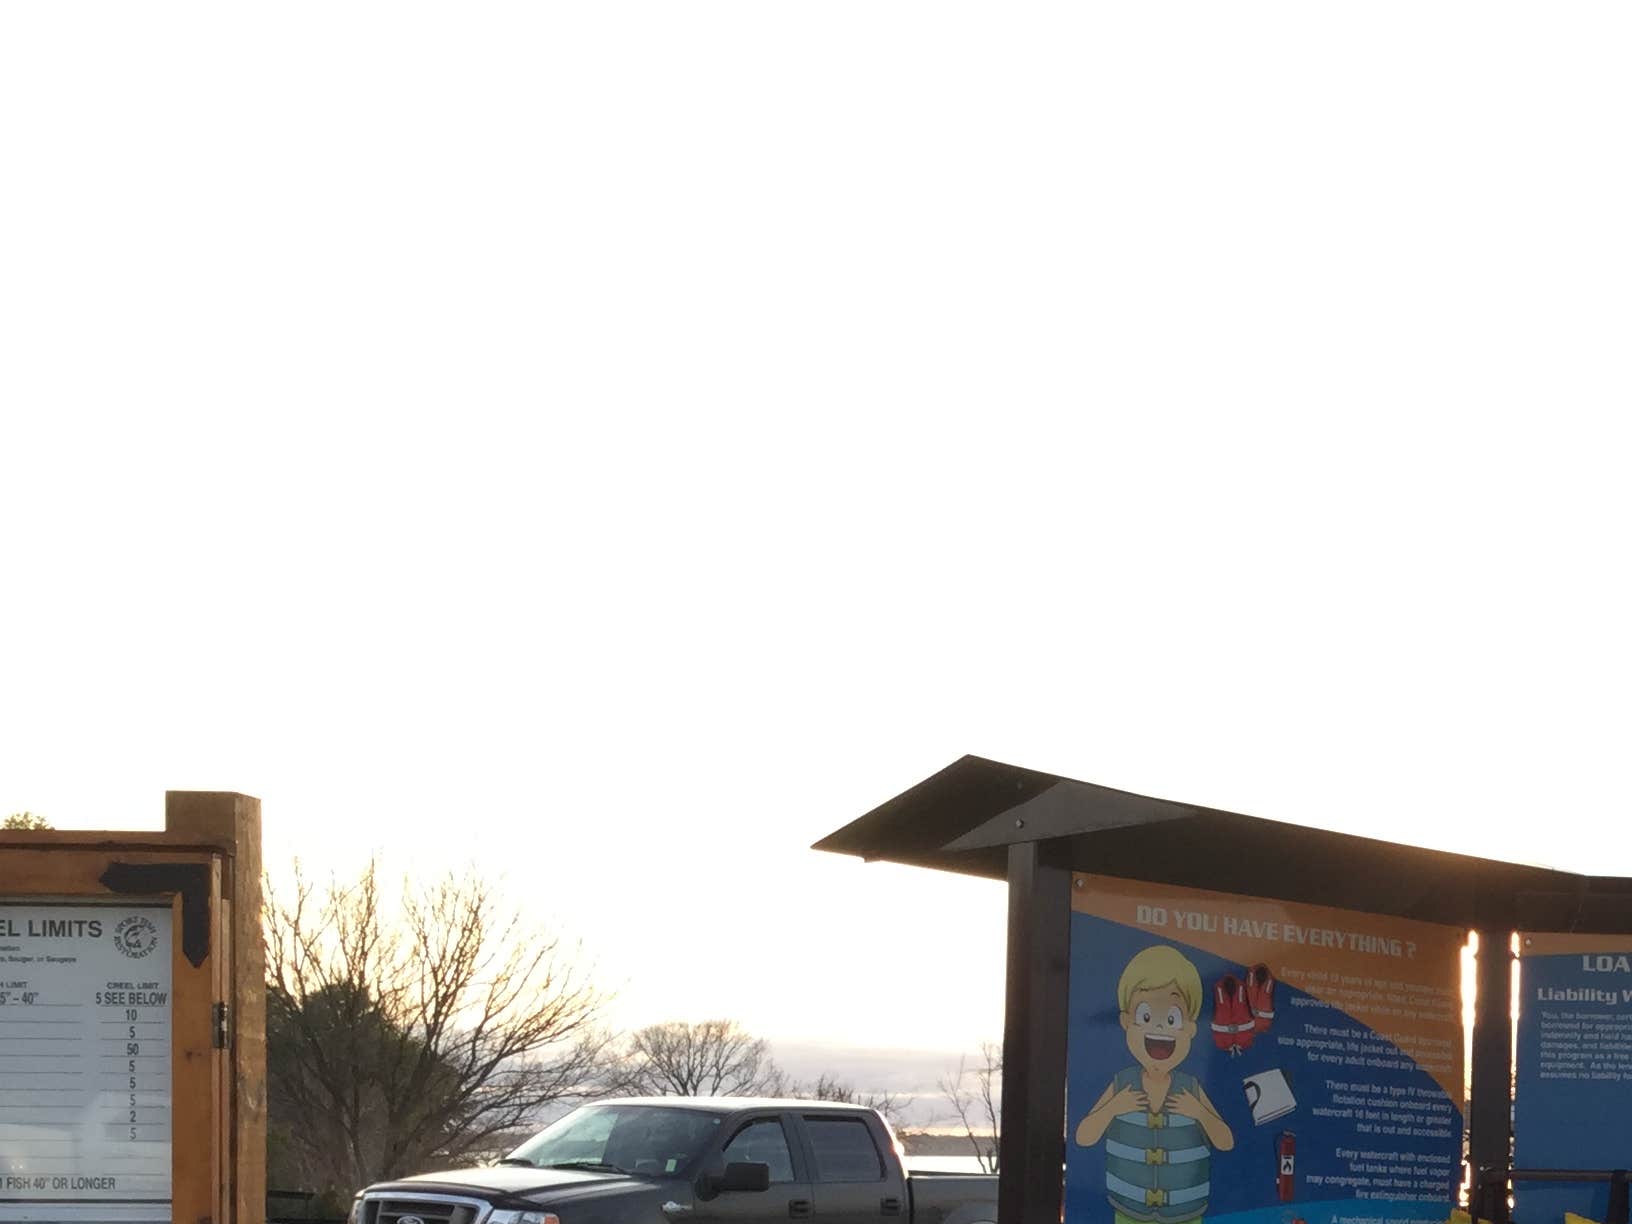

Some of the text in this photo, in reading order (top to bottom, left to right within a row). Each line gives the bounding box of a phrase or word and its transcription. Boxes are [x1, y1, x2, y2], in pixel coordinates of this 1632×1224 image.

[28, 919, 102, 938] LIMITS
[1136, 905, 1168, 926] DO
[1174, 911, 1218, 932] YOU
[1224, 916, 1278, 941] HAVE
[1284, 924, 1402, 956] EVERYTHING
[106, 982, 160, 990] CREEL LIMIT
[96, 992, 168, 1006] 5 SEE BELOW
[1537, 988, 1617, 1005] Liability
[126, 1009, 137, 1021] 10
[129, 1026, 136, 1038] 5
[127, 1042, 139, 1055] 50
[129, 1060, 135, 1072] 5
[130, 1077, 136, 1089] 5
[130, 1094, 136, 1106] 5
[130, 1110, 136, 1122] 2
[130, 1128, 136, 1140] 5
[7, 1177, 30, 1190] FISH
[52, 1177, 68, 1190] OR
[71, 1178, 116, 1190] LONGER
